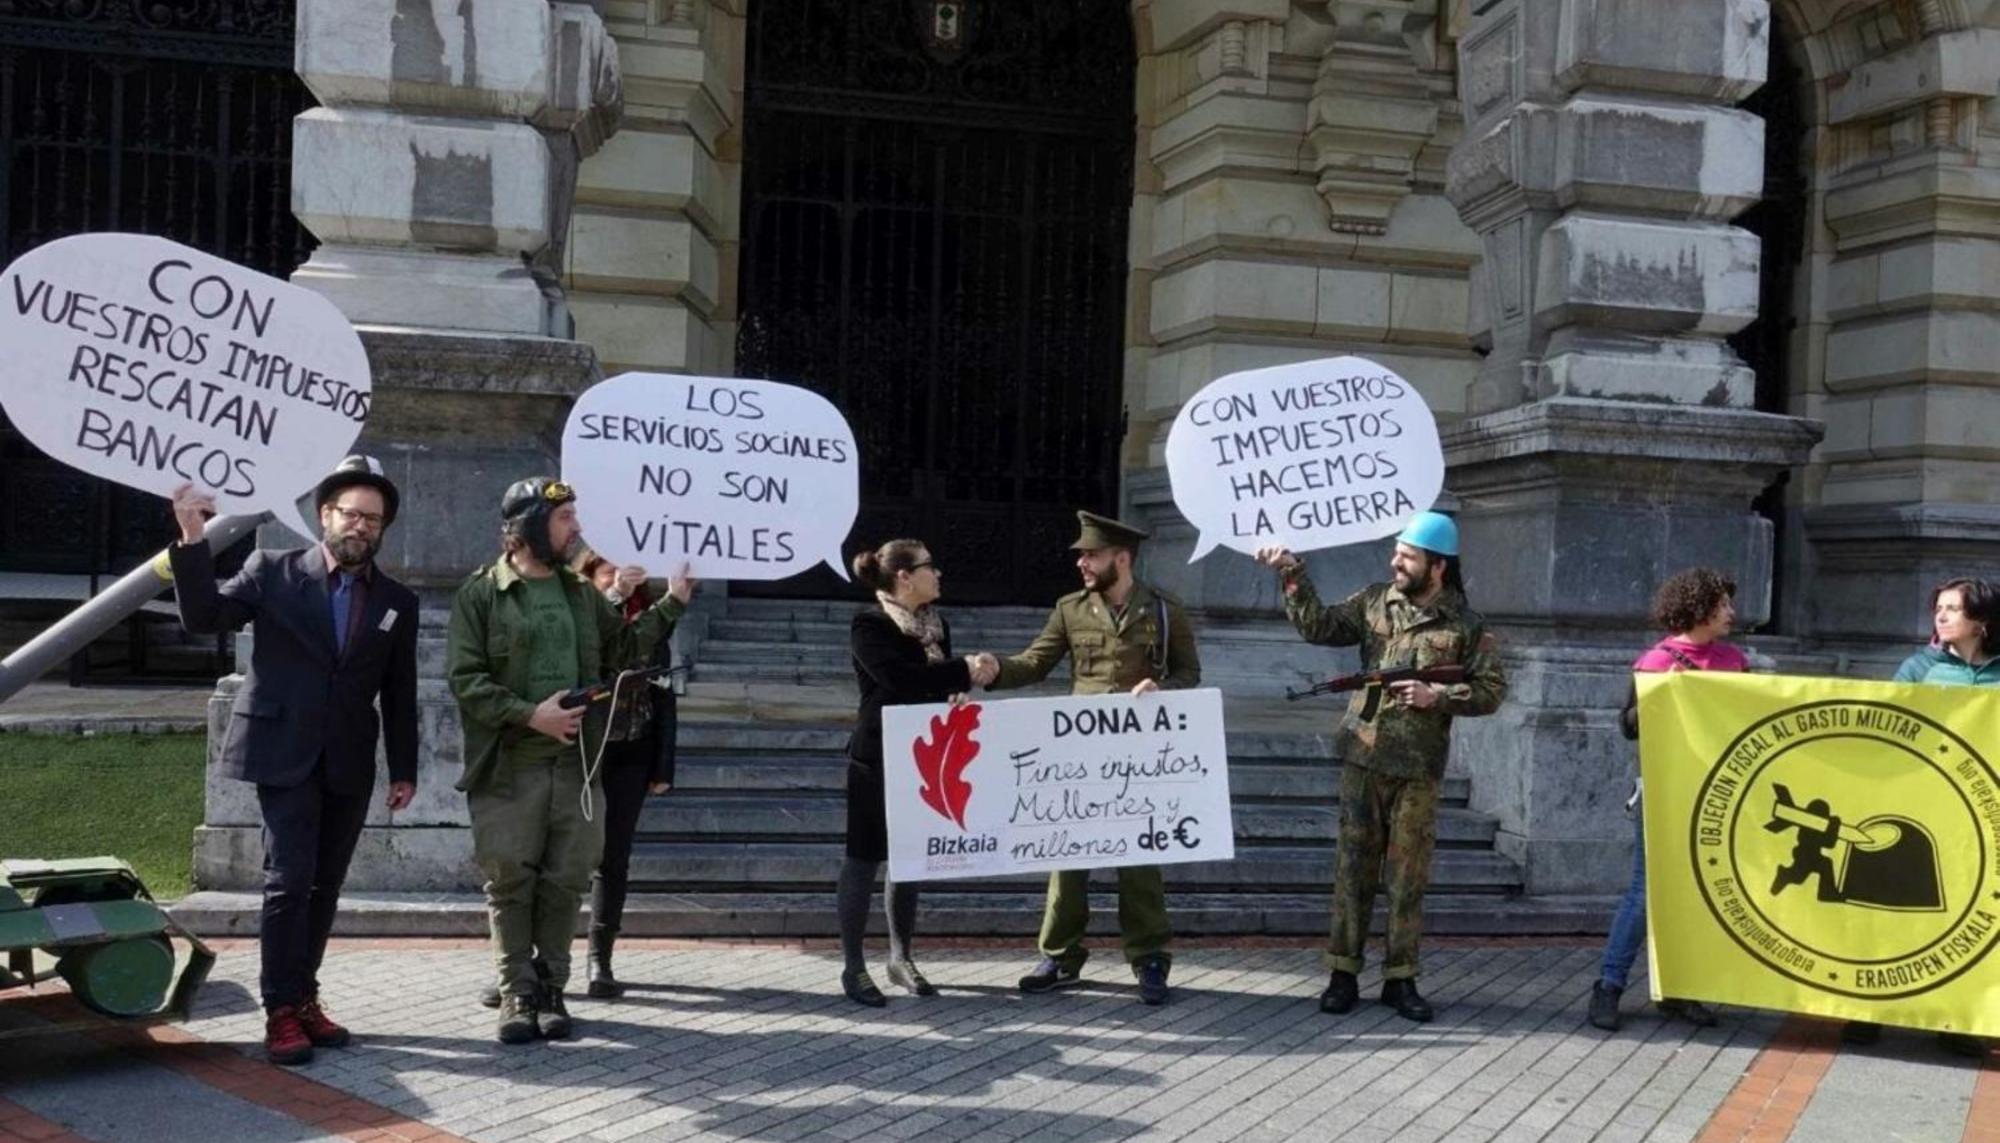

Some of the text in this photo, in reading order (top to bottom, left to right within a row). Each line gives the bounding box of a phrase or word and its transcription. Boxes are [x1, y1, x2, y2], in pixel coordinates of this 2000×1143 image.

[148, 259, 275, 338] CON
[13, 274, 372, 422] VUESTROS IMPUESTOS
[68, 344, 278, 446] RESCATAN
[686, 384, 765, 420] LOS
[1190, 374, 1406, 427] CON VUESTROS
[76, 407, 257, 498] BANCOS
[1211, 408, 1403, 467] IMPUESTOS
[639, 464, 788, 504] NO SON
[1230, 450, 1399, 500] HACEMOS
[1231, 488, 1416, 537] LA GUERRA
[1053, 708, 1142, 738] DONA
[1726, 732, 1774, 777] FISCAL
[1771, 720, 1795, 742] AL
[1796, 707, 1849, 733] GASTO
[1855, 708, 1921, 742] MILITAR
[1009, 747, 1088, 787] Fines
[1008, 788, 1182, 825] Millones y
[927, 833, 998, 857] Bizkaia
[1009, 829, 1129, 860] millones
[1855, 909, 1997, 988] ERAGOZPEN FISKALA
